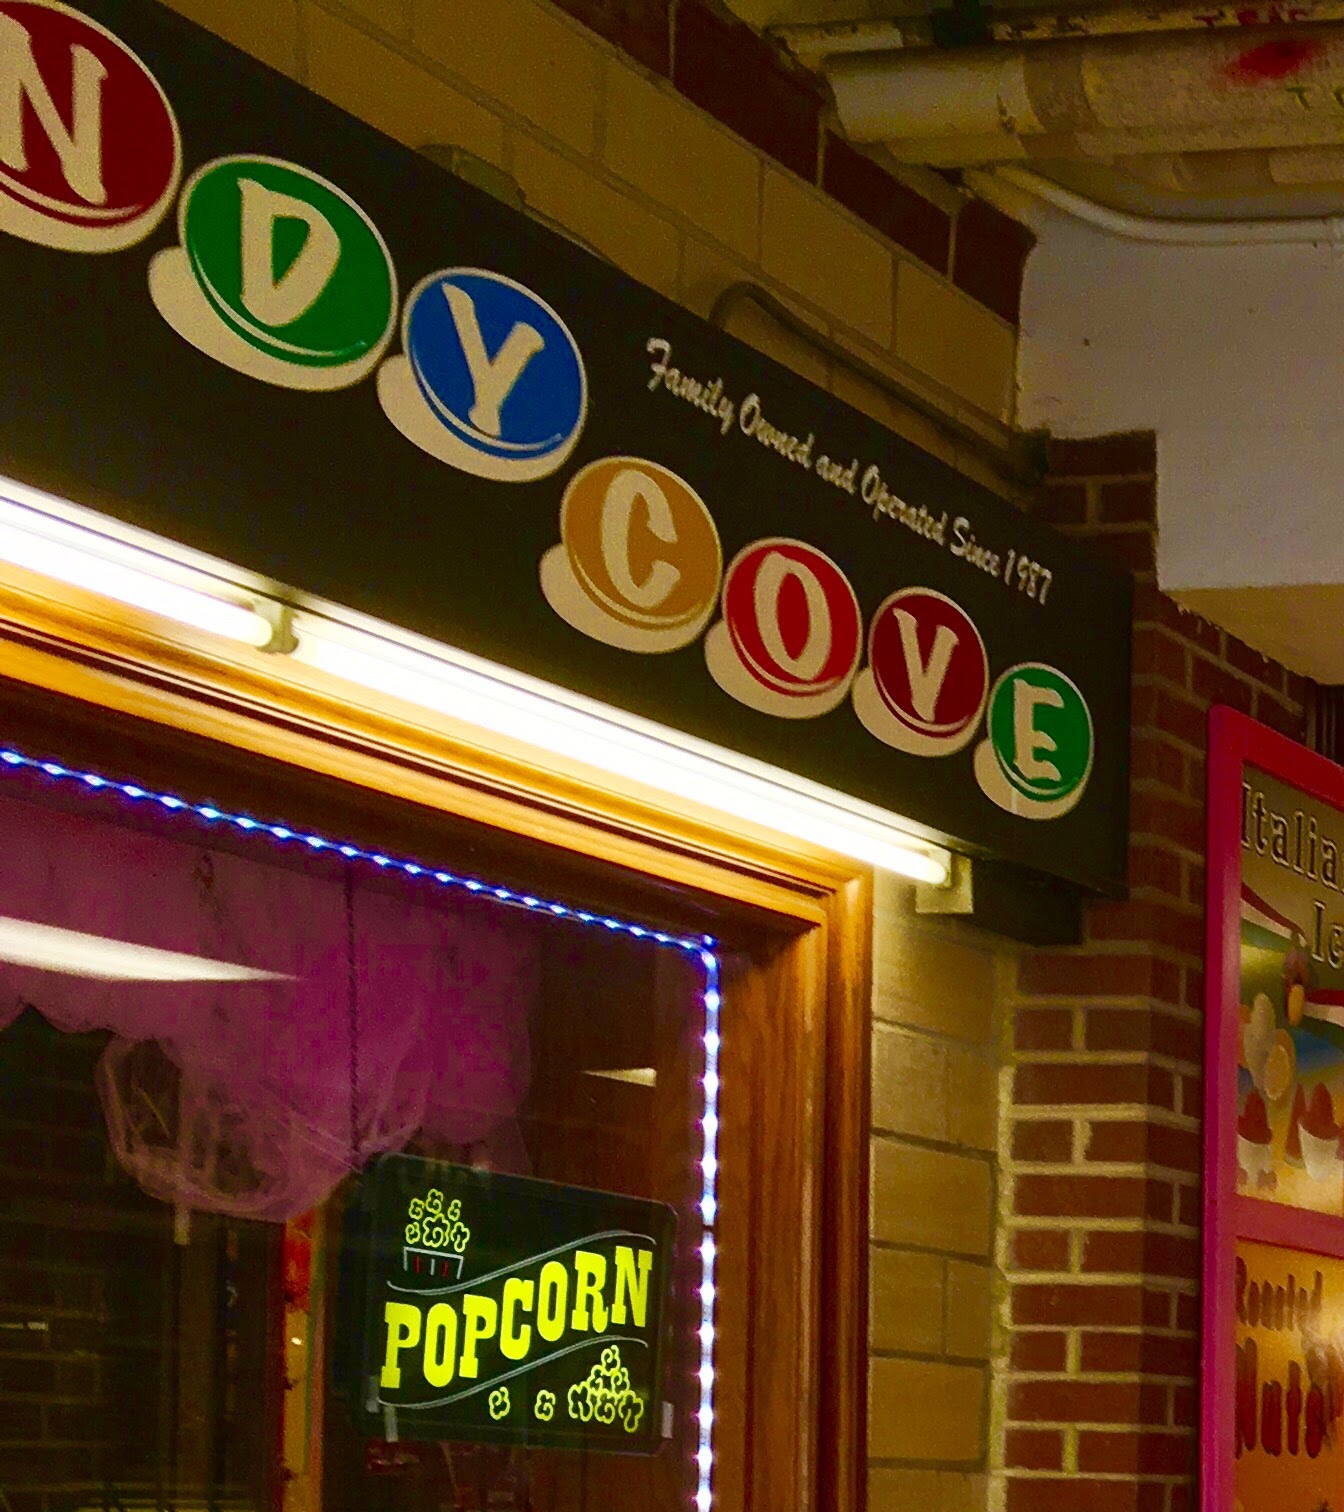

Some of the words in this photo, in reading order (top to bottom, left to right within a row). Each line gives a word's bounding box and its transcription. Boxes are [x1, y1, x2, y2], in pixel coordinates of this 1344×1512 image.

[646, 337, 735, 434] Family
[739, 393, 813, 470] Owned
[815, 454, 858, 496] and
[860, 465, 948, 546] Operated
[949, 516, 1000, 578] Since
[1004, 549, 1053, 605] 1987
[598, 467, 1065, 785] COVE
[380, 1244, 653, 1390] POPCORN
